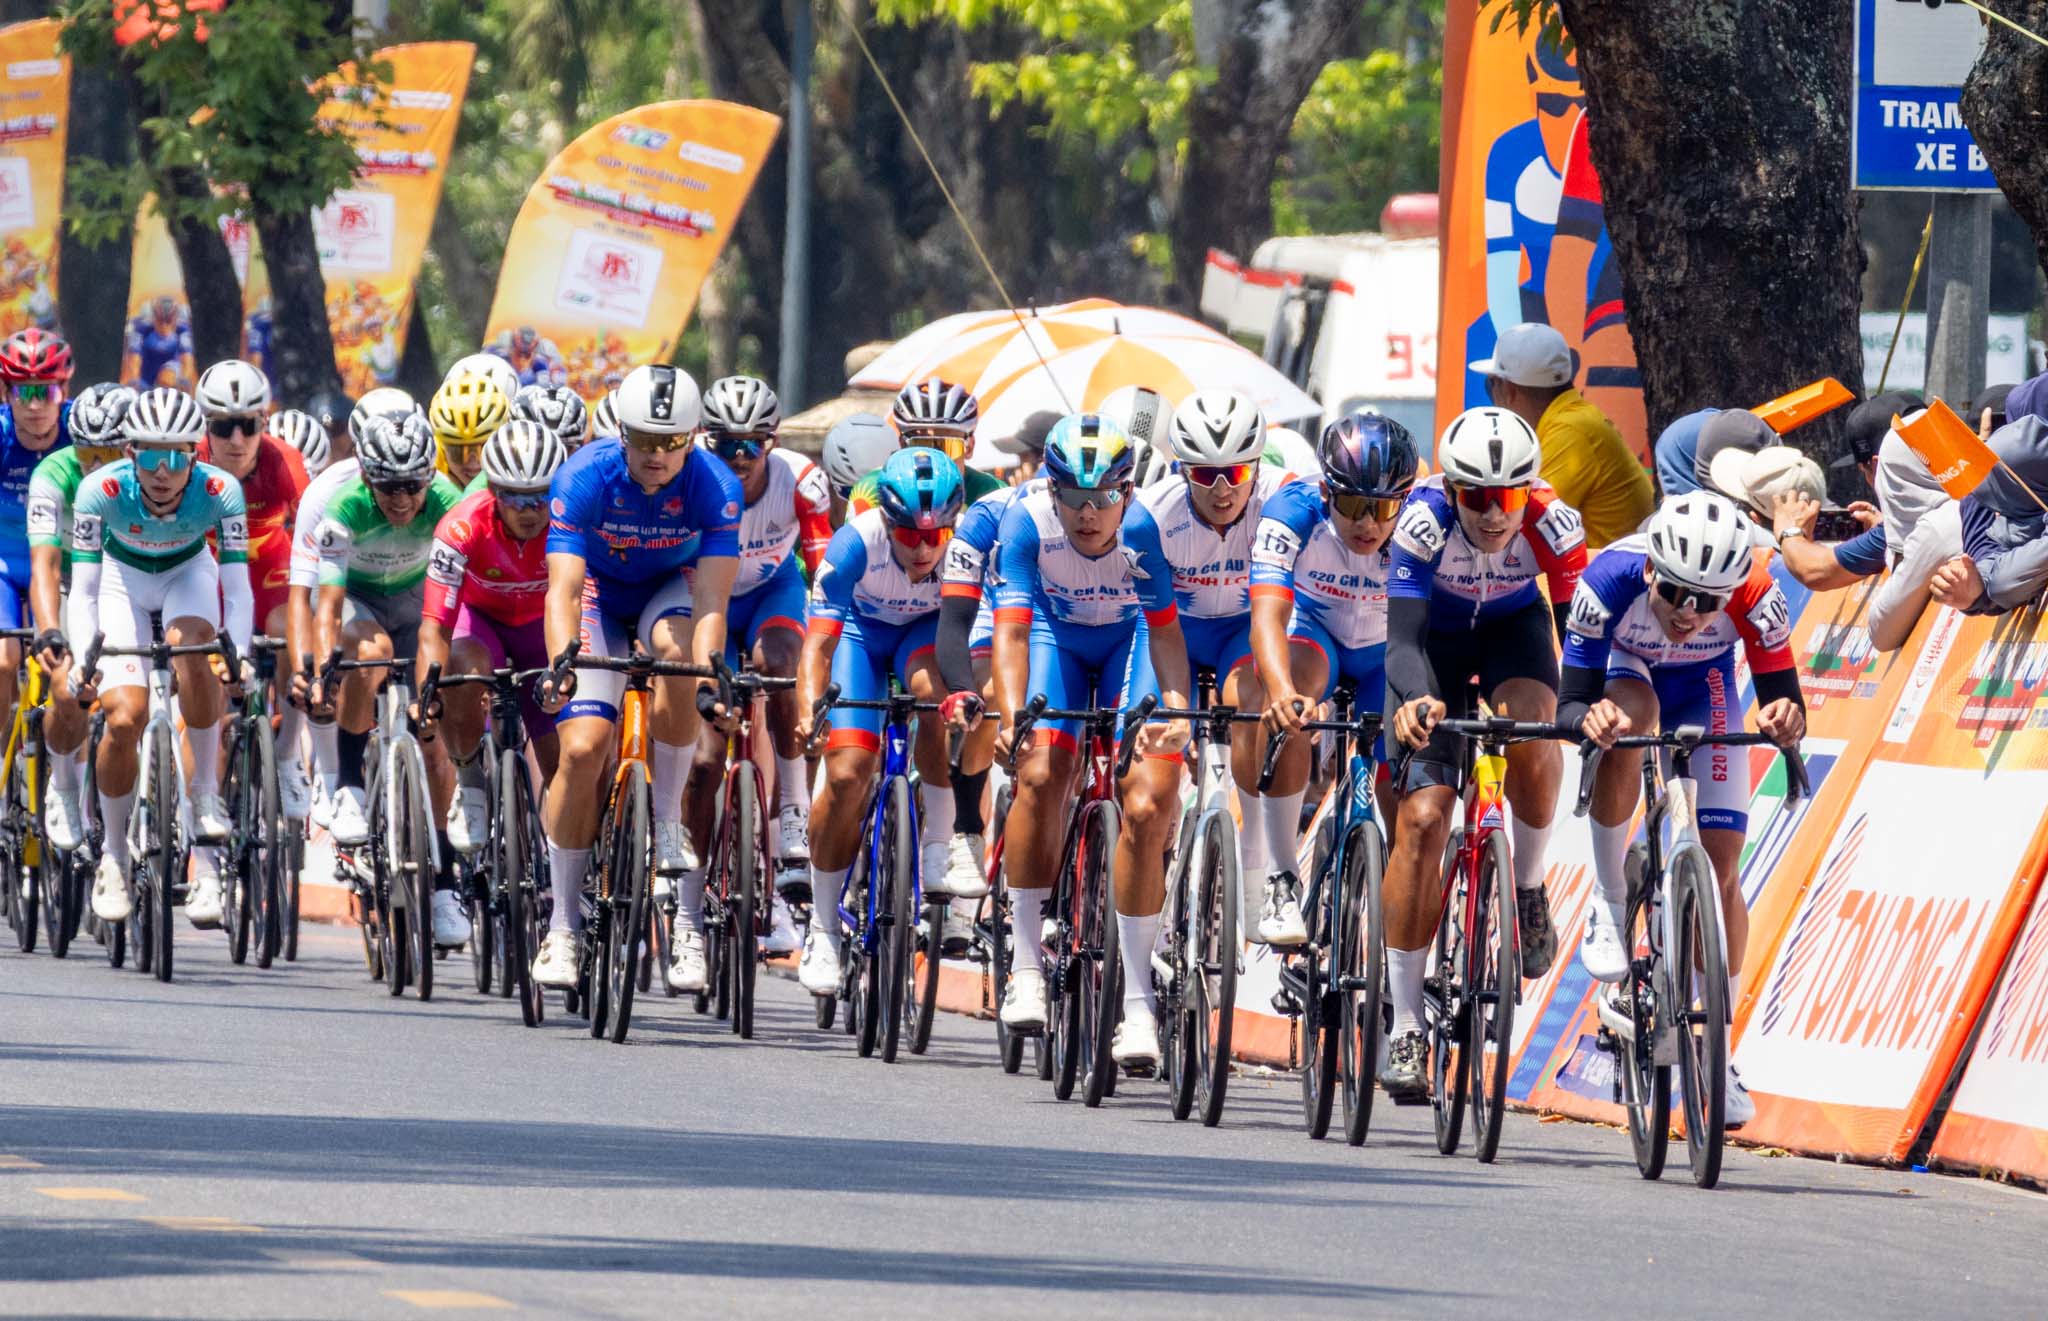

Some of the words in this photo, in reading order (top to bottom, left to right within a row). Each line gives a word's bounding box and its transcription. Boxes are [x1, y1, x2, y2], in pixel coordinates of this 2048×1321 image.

[1914, 143, 1957, 171] XE
[1968, 144, 1993, 171] B
[1711, 755, 1728, 782] 620
